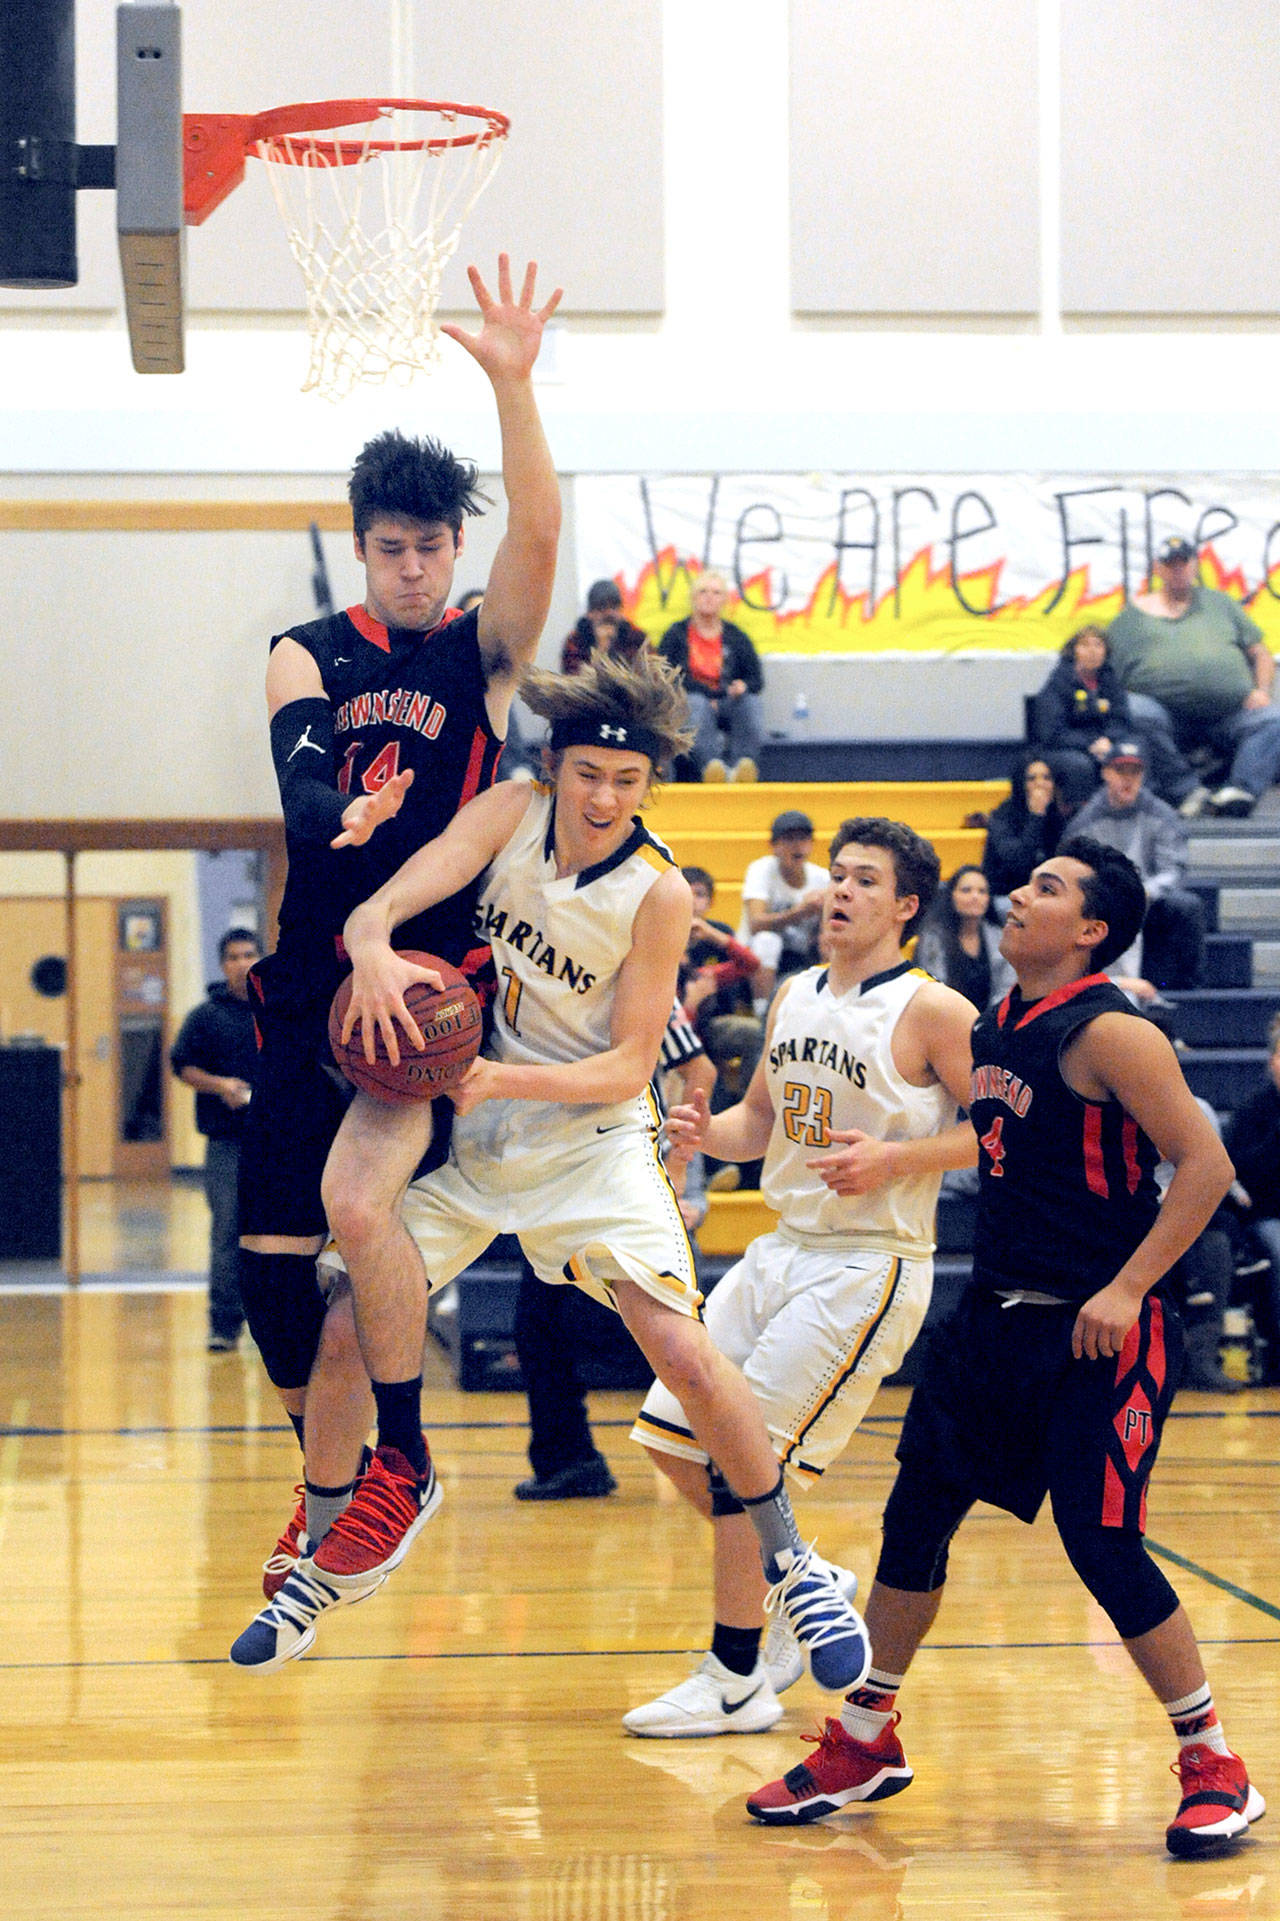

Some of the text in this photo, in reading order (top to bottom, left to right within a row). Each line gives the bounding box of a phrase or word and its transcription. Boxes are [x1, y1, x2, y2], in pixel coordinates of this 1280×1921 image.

[639, 472, 789, 611] We
[828, 486, 1006, 619] Are
[334, 688, 447, 740] OWNSEND
[338, 741, 401, 795] 14
[770, 1037, 867, 1090] SPARTANS
[783, 1081, 833, 1148] 23
[980, 1117, 1006, 1177] 4
[1124, 1406, 1152, 1446] PT
